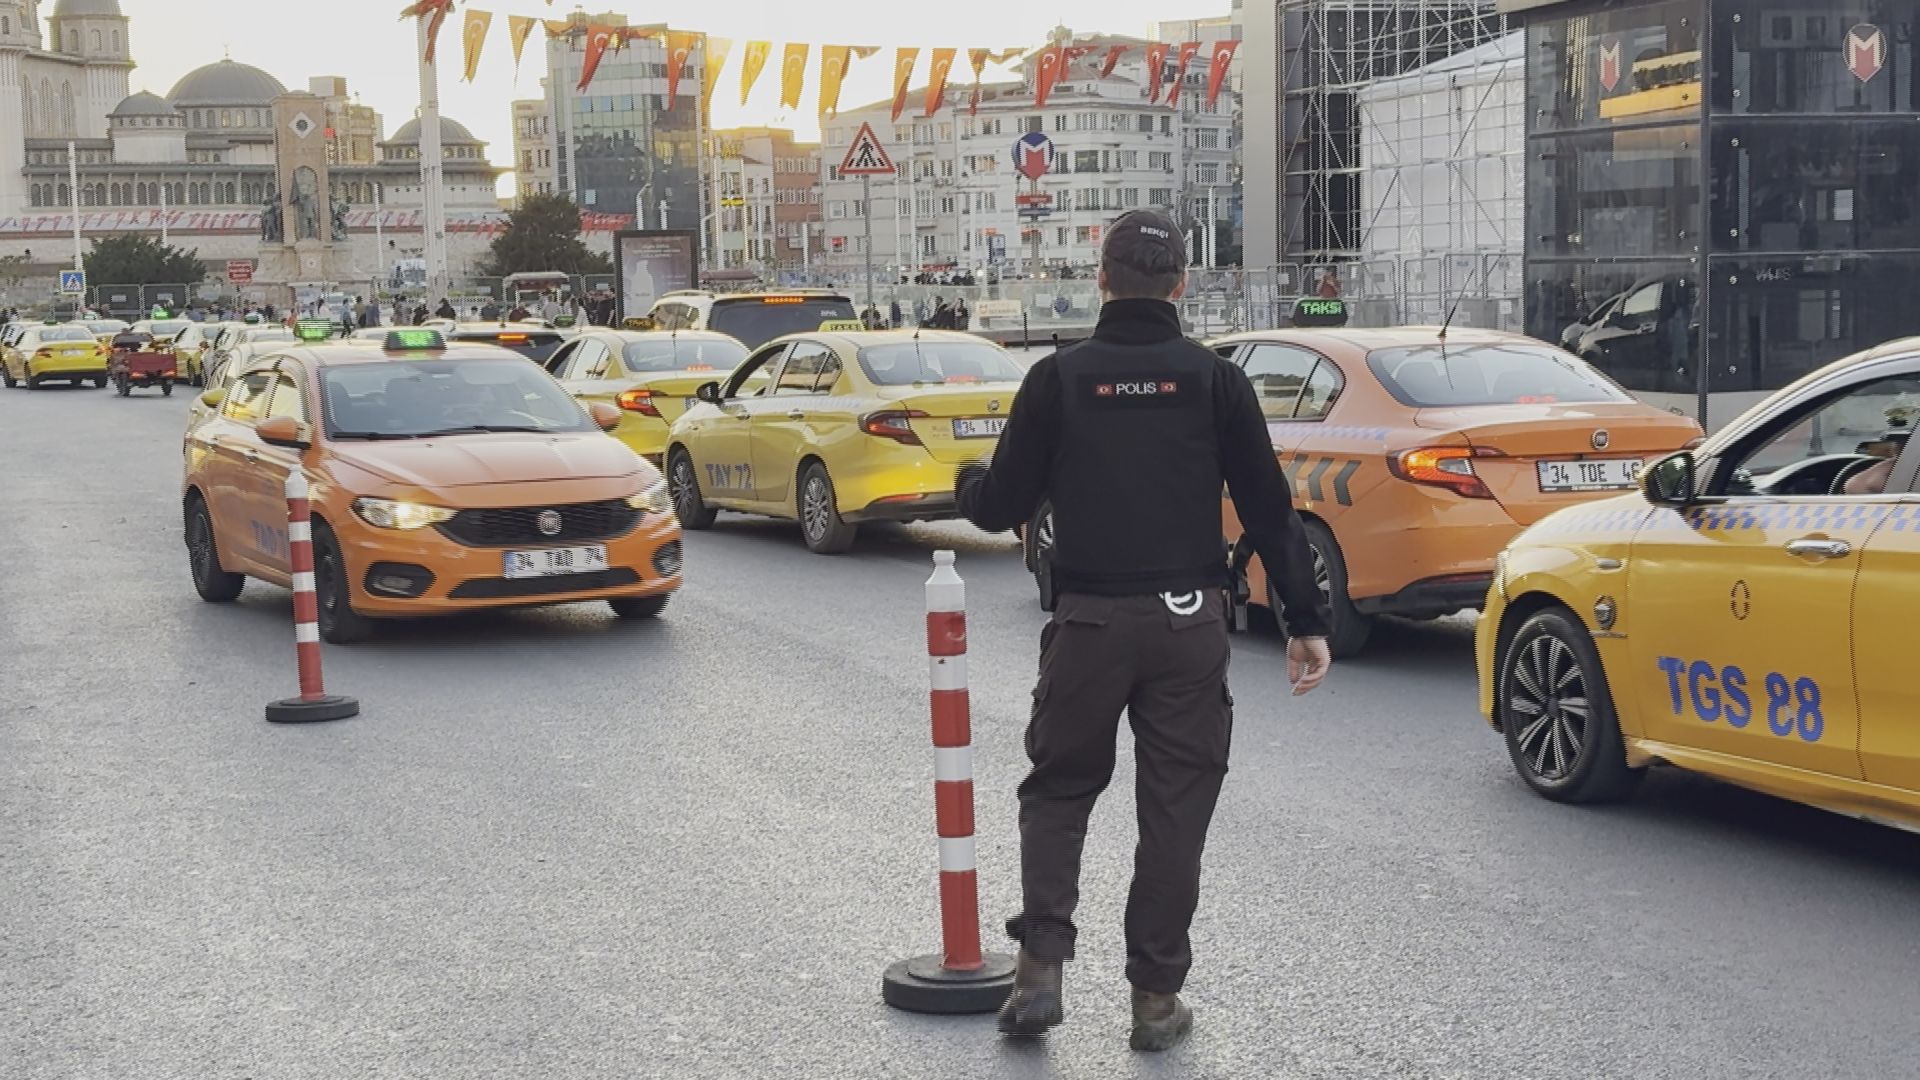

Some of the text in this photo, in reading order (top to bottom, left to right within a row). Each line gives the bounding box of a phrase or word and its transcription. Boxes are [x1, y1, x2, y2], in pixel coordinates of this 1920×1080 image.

[1849, 30, 1882, 70] M
[1020, 140, 1050, 168] M
[704, 463, 752, 489] TAY 72
[1550, 464, 1570, 483] 34
[1578, 463, 1608, 482] TDE
[515, 553, 535, 571] 34
[1656, 655, 1825, 743] TGS 88
